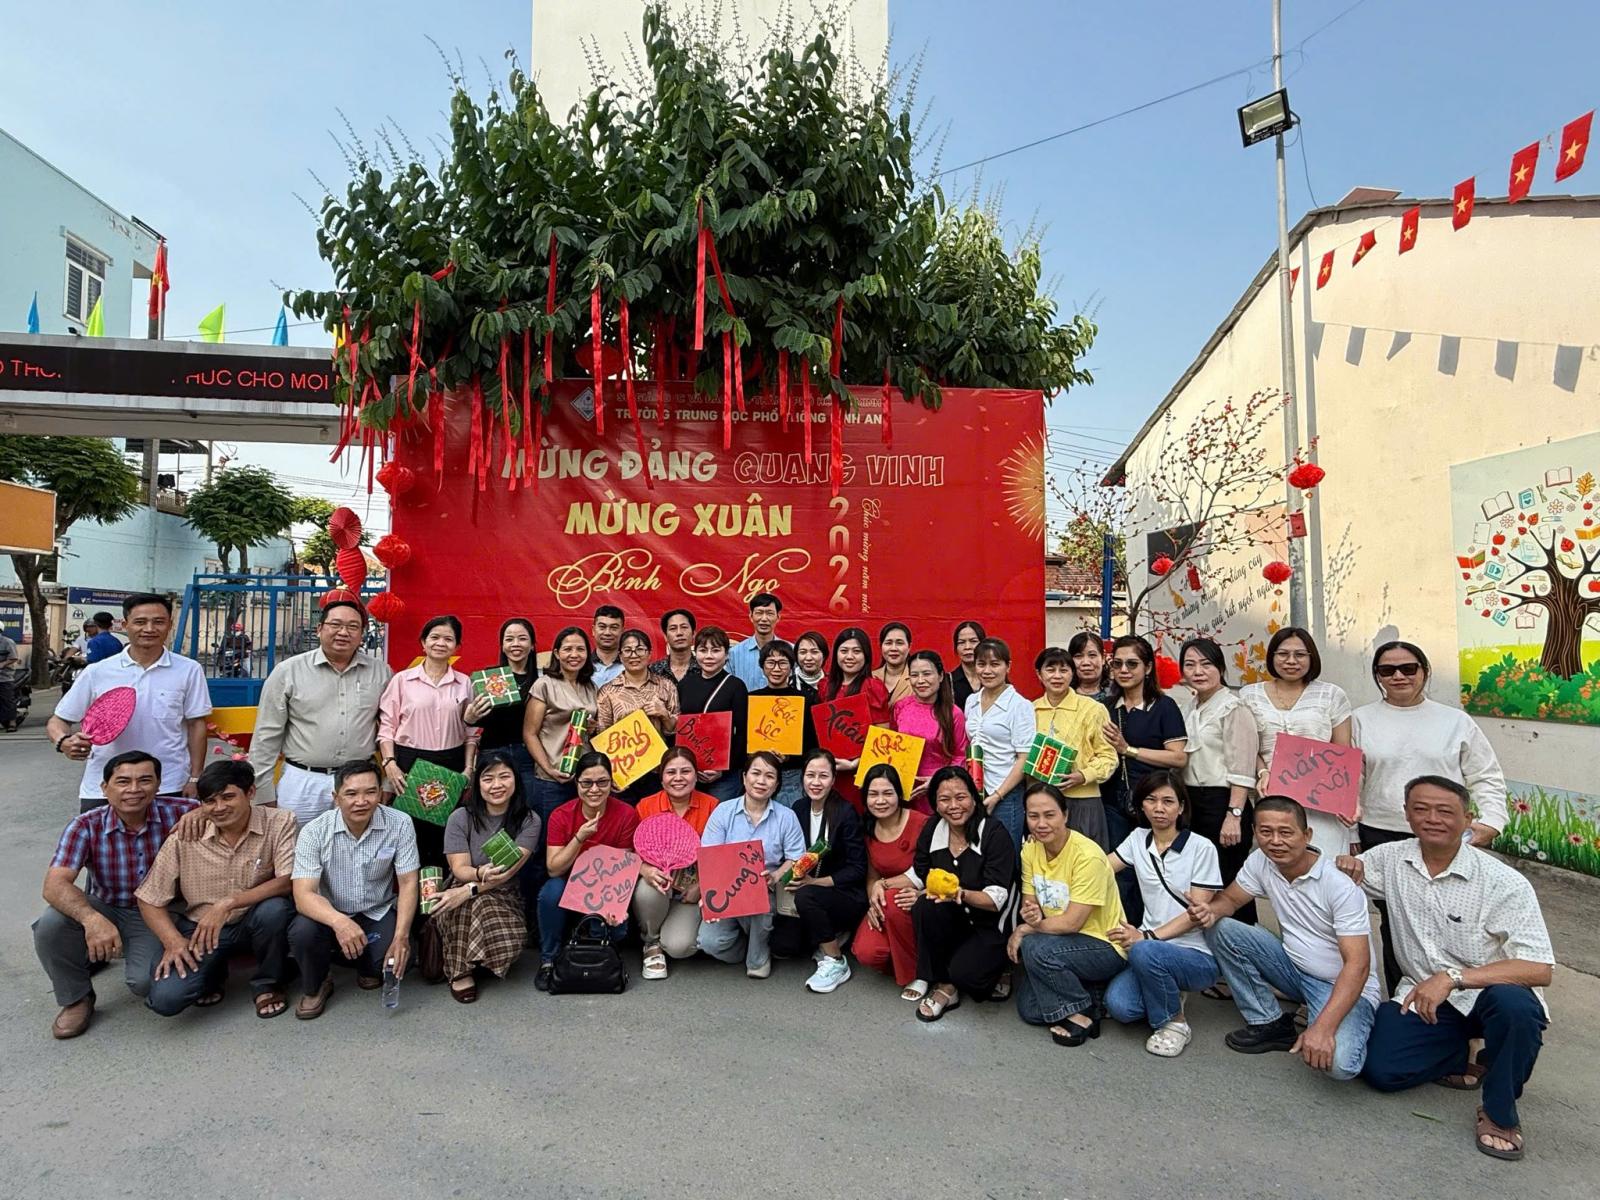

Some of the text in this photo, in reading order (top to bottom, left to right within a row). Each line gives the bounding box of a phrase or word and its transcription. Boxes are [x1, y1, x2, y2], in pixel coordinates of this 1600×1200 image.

[237, 370, 284, 388] CHO
[674, 409, 718, 421] TRUNG
[752, 408, 779, 422] PHỔ
[863, 413, 882, 425] AN
[618, 439, 717, 482] ĐẢNG
[733, 451, 856, 485] QUANG
[866, 455, 944, 487] VINH
[564, 489, 793, 538] MỪNG XUÂN
[829, 496, 850, 614] 2026
[606, 720, 652, 757] Bình
[755, 715, 782, 743] Lộc
[1278, 748, 1345, 786] năm
[1306, 765, 1352, 806] mới
[570, 852, 637, 888] Thành
[583, 878, 635, 911] Công
[705, 867, 759, 914] Cung
